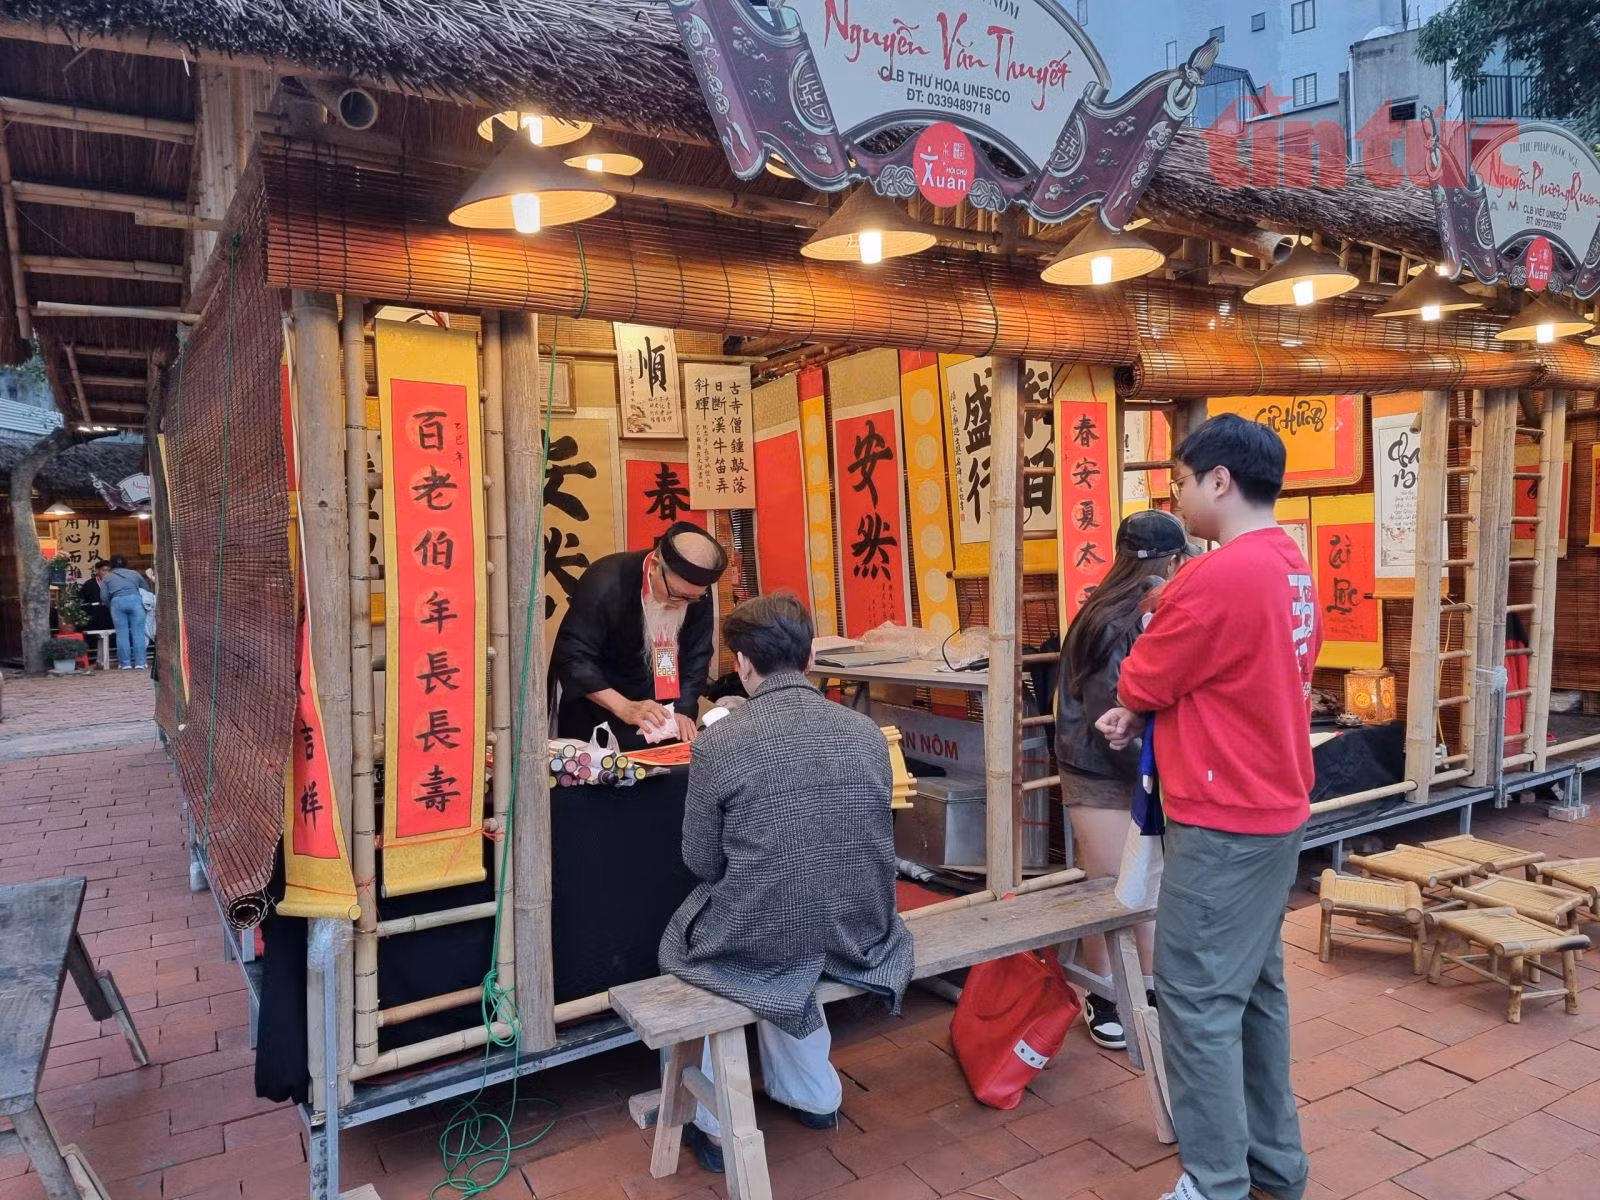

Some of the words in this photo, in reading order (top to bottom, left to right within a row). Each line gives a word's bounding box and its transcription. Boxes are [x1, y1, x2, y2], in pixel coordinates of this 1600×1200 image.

[937, 12, 990, 70] Văn
[880, 66, 904, 83] CLB
[907, 70, 933, 88] THƯ
[963, 83, 1011, 104] UNESCO
[906, 90, 925, 104] ĐT:
[927, 93, 992, 116] 0339489718
[636, 335, 668, 397] 順
[412, 411, 461, 813] 百老伯年長長壽
[920, 733, 959, 760] NÔM
